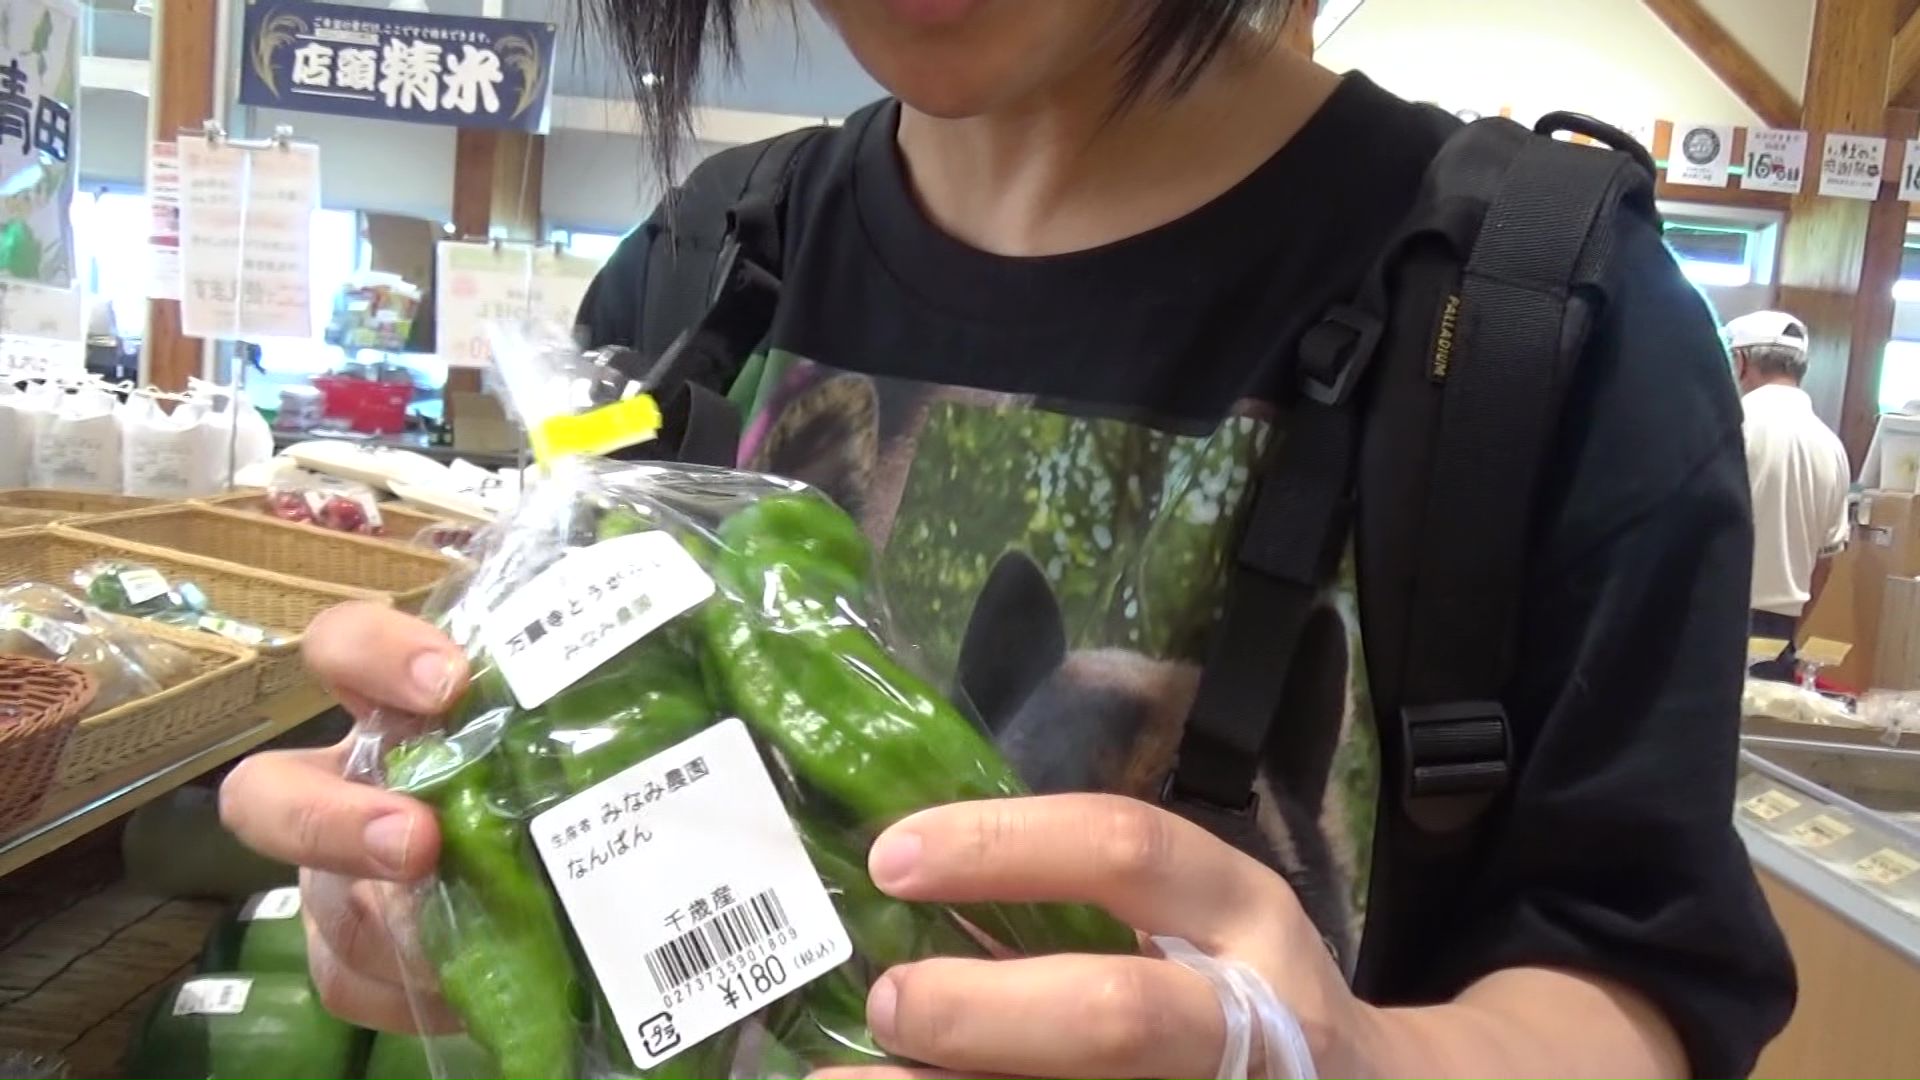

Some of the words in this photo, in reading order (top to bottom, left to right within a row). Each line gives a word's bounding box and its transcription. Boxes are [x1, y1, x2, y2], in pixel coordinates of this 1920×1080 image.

[291, 37, 503, 112] 店頭精米
[1433, 295, 1460, 376] PALLADIUM
[601, 756, 710, 824] みなみ農園
[567, 824, 653, 880] なんばん
[664, 885, 736, 932] 千歳産
[664, 928, 798, 1009] 0273735901809
[718, 954, 787, 1010] ¥180
